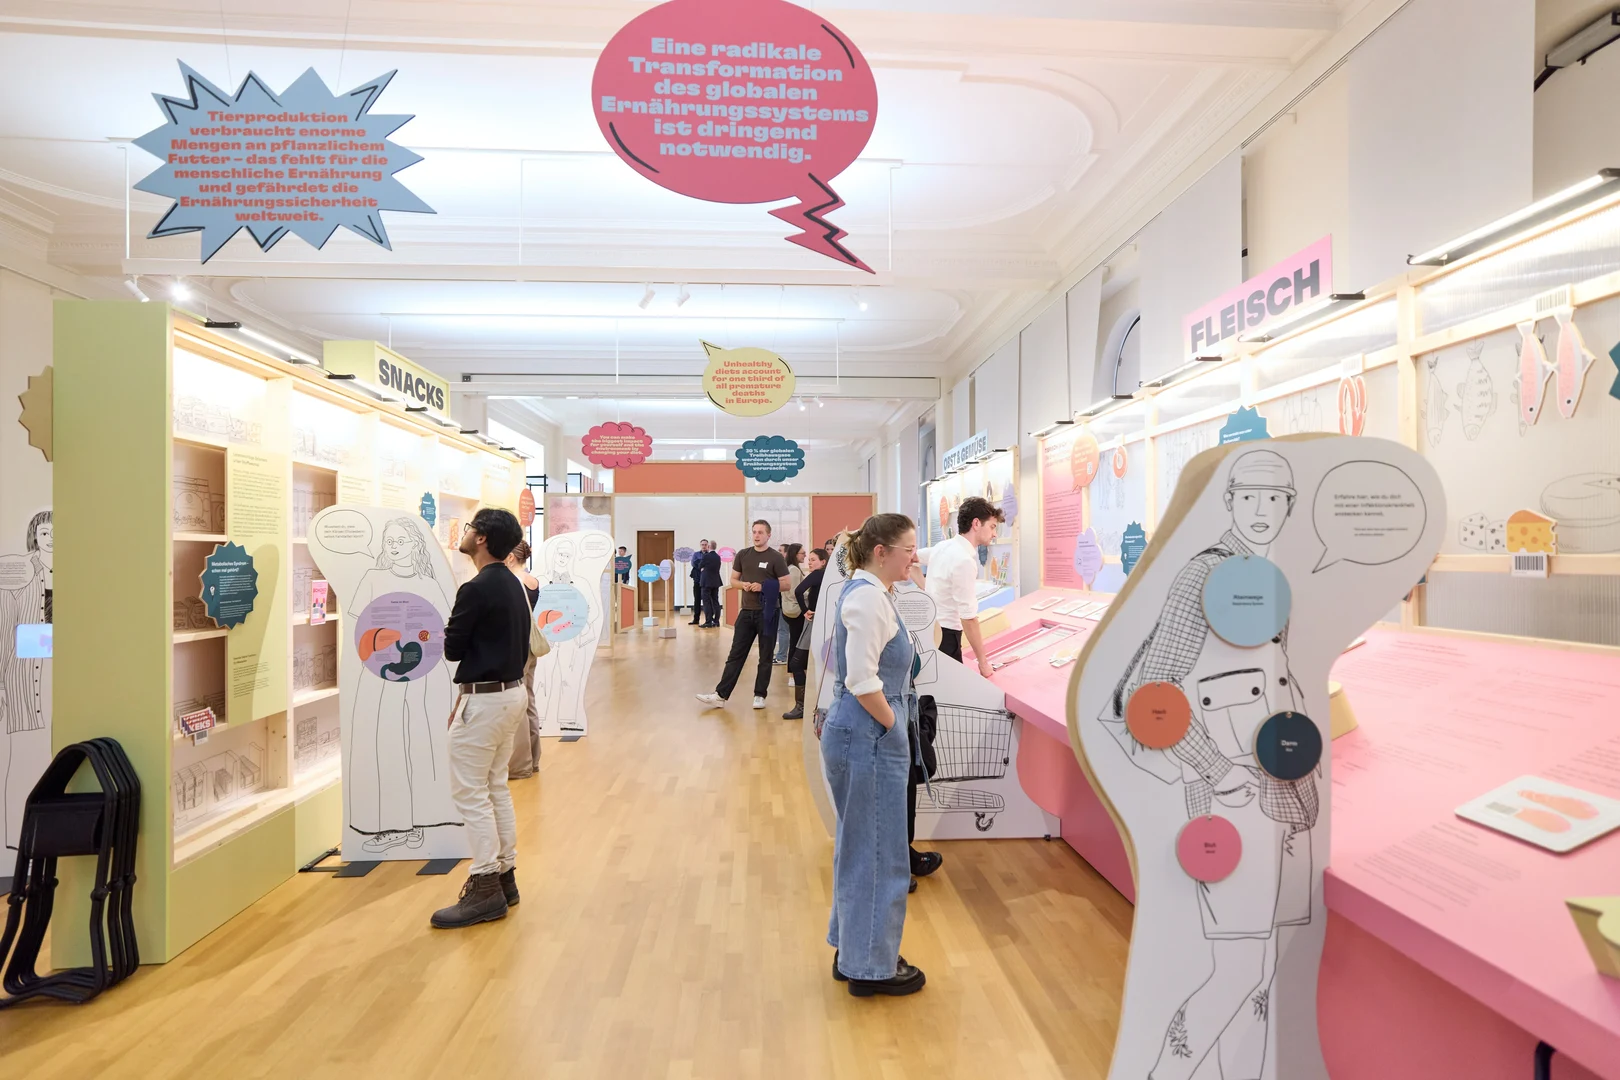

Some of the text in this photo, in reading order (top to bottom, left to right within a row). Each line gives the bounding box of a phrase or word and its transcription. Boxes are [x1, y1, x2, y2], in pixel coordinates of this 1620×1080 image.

[651, 37, 822, 61] Eine radikale
[628, 57, 843, 82] Transformation
[654, 79, 817, 101] des globalen
[601, 96, 869, 123] Ernährungssystems
[207, 111, 348, 123] Tierproduktion
[189, 126, 366, 137] verbraucht enorme
[654, 119, 817, 143] ist dringend
[171, 139, 385, 153] Mengen an pflanzlichem
[659, 141, 812, 164] notwendig.
[168, 154, 231, 165] Futter
[246, 154, 278, 165] das
[280, 154, 325, 165] fehlt
[329, 154, 358, 165] für
[361, 155, 388, 166] die
[174, 168, 382, 181] menschliche Ernährung
[199, 182, 359, 195] und gefährdet die
[180, 196, 378, 209] Ernährungssicherheit
[235, 210, 324, 221] weltweit.
[1190, 258, 1320, 355] FLEISCH
[723, 361, 773, 369] Unhealthy
[378, 358, 444, 412] SNACKS
[729, 383, 781, 391] premature
[736, 397, 772, 405] Europe.
[943, 452, 957, 471] OBST
[961, 435, 986, 462] GEMÜSE
[188, 719, 211, 732] KEKS
